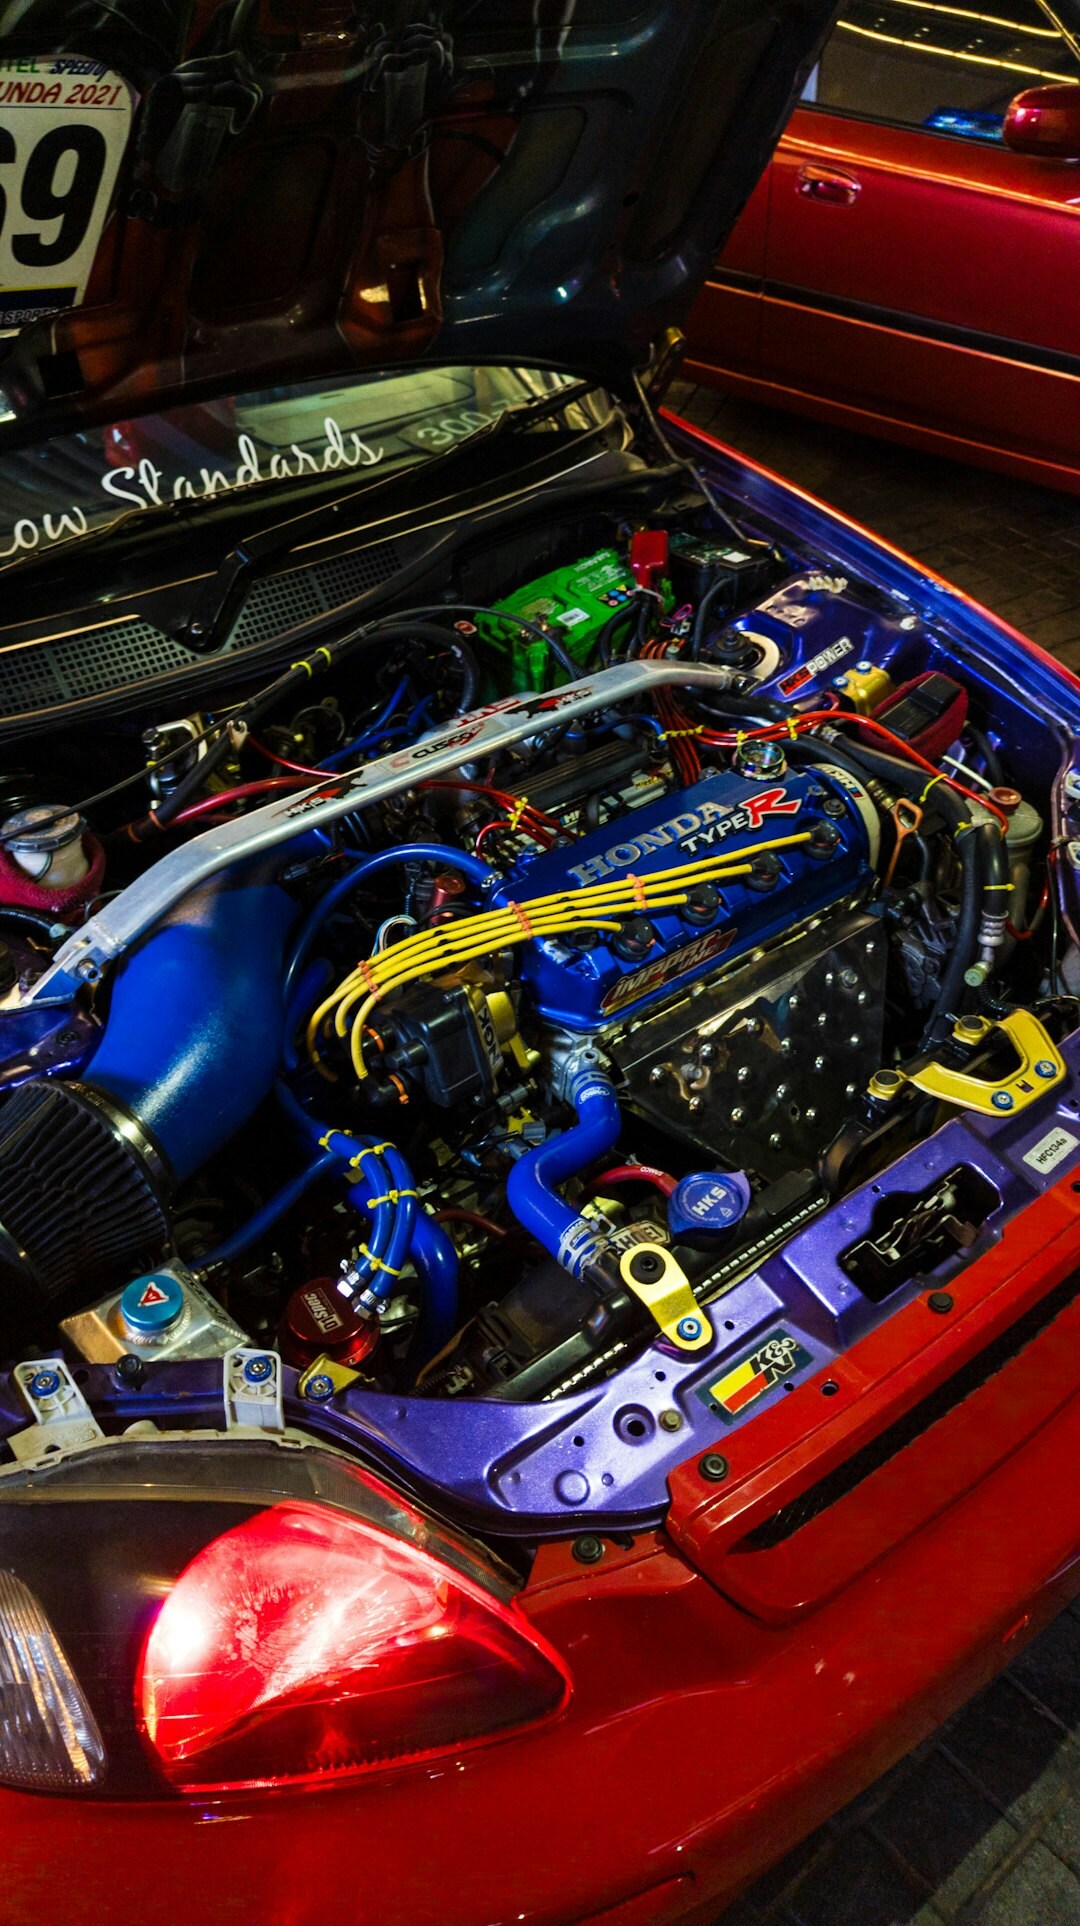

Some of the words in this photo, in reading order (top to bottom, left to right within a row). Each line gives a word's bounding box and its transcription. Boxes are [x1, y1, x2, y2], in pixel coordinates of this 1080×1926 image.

[0, 57, 39, 73] TEL
[64, 83, 122, 106] 2021
[0, 124, 107, 267] 9
[3, 307, 60, 326] SPORT
[101, 417, 384, 509] Standards
[805, 636, 854, 676] POWER
[282, 796, 327, 818] HKS
[680, 811, 749, 855] TYPE
[737, 787, 803, 829] R
[567, 801, 734, 887] HONDA
[477, 1007, 502, 1067] NGK
[1035, 1137, 1068, 1165] HFC134a
[640, 1165, 665, 1177] SAMCO
[691, 1185, 728, 1217] HKS
[748, 1337, 799, 1387] K&N
